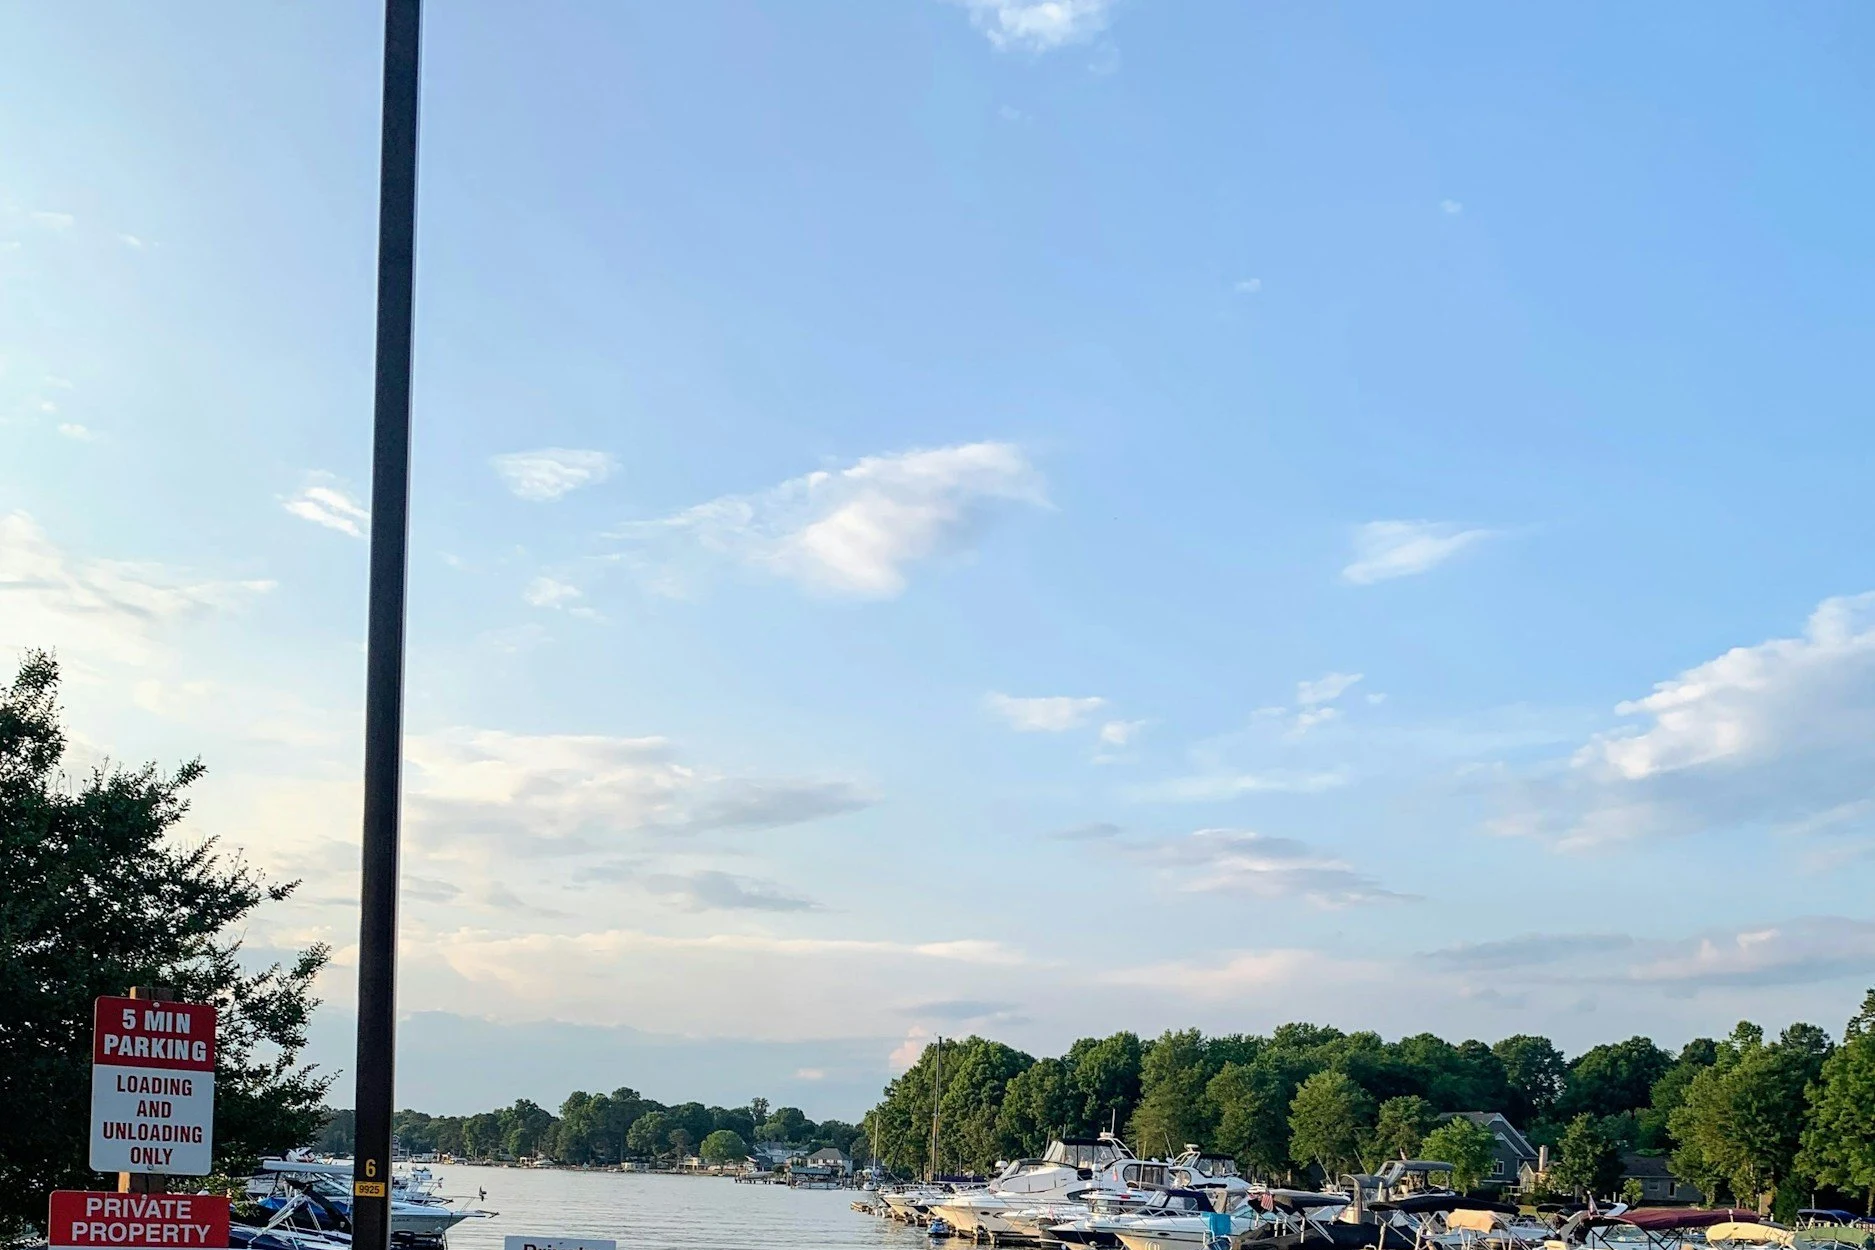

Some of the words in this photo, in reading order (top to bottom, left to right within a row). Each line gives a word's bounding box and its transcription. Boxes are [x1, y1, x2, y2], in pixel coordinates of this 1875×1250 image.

[122, 1008, 137, 1030] 5
[144, 1010, 191, 1034] MIN
[104, 1033, 207, 1062] PARKING
[117, 1074, 193, 1097] LOADING
[136, 1100, 172, 1119] AND
[103, 1121, 203, 1144] UNLOADING
[130, 1146, 173, 1166] ONLY
[365, 1158, 377, 1178] 6
[359, 1184, 380, 1195] 9925
[85, 1197, 192, 1220] PRIVATE
[71, 1222, 211, 1244] PROPERTY
